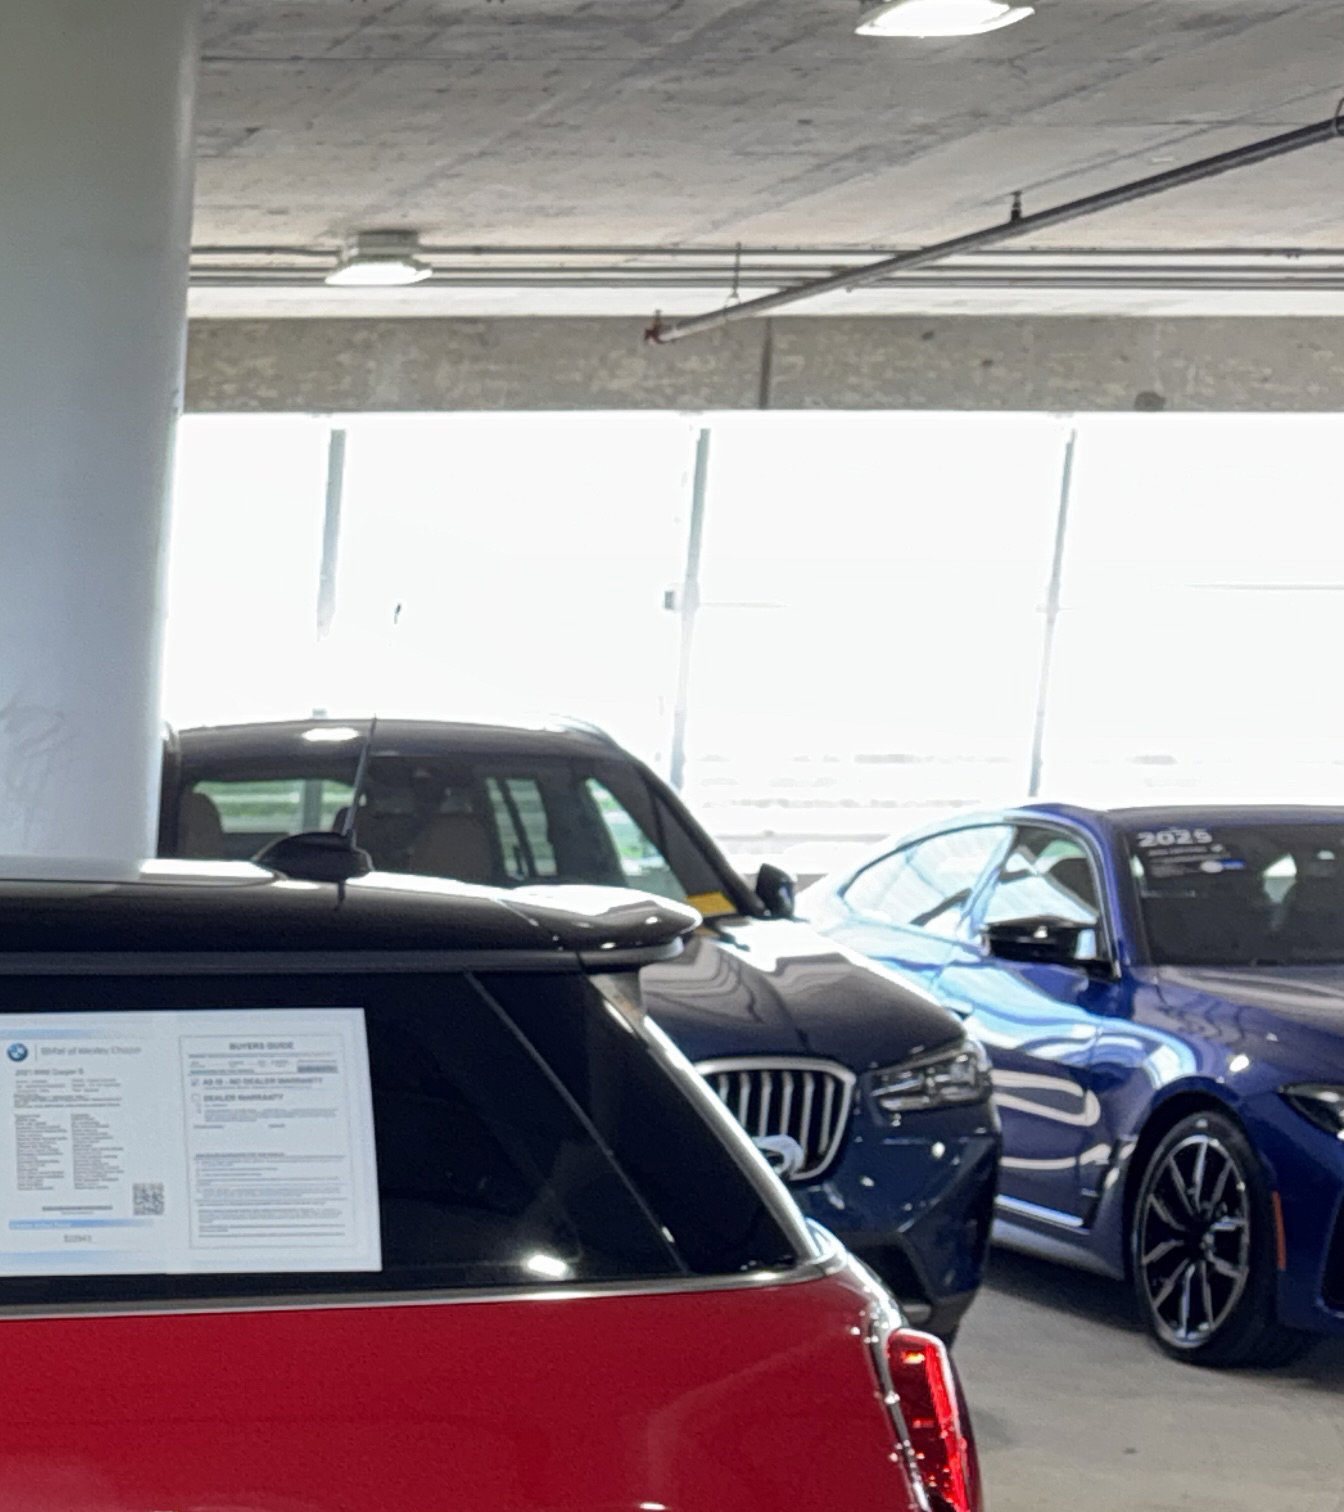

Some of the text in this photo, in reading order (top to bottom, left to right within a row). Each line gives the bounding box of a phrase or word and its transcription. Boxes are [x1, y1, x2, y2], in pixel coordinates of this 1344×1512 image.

[1136, 828, 1214, 848] 2025
[229, 1041, 294, 1051] BUYERS GUIDE
[242, 1077, 276, 1086] DEALER
[203, 1094, 236, 1103] DEALER
